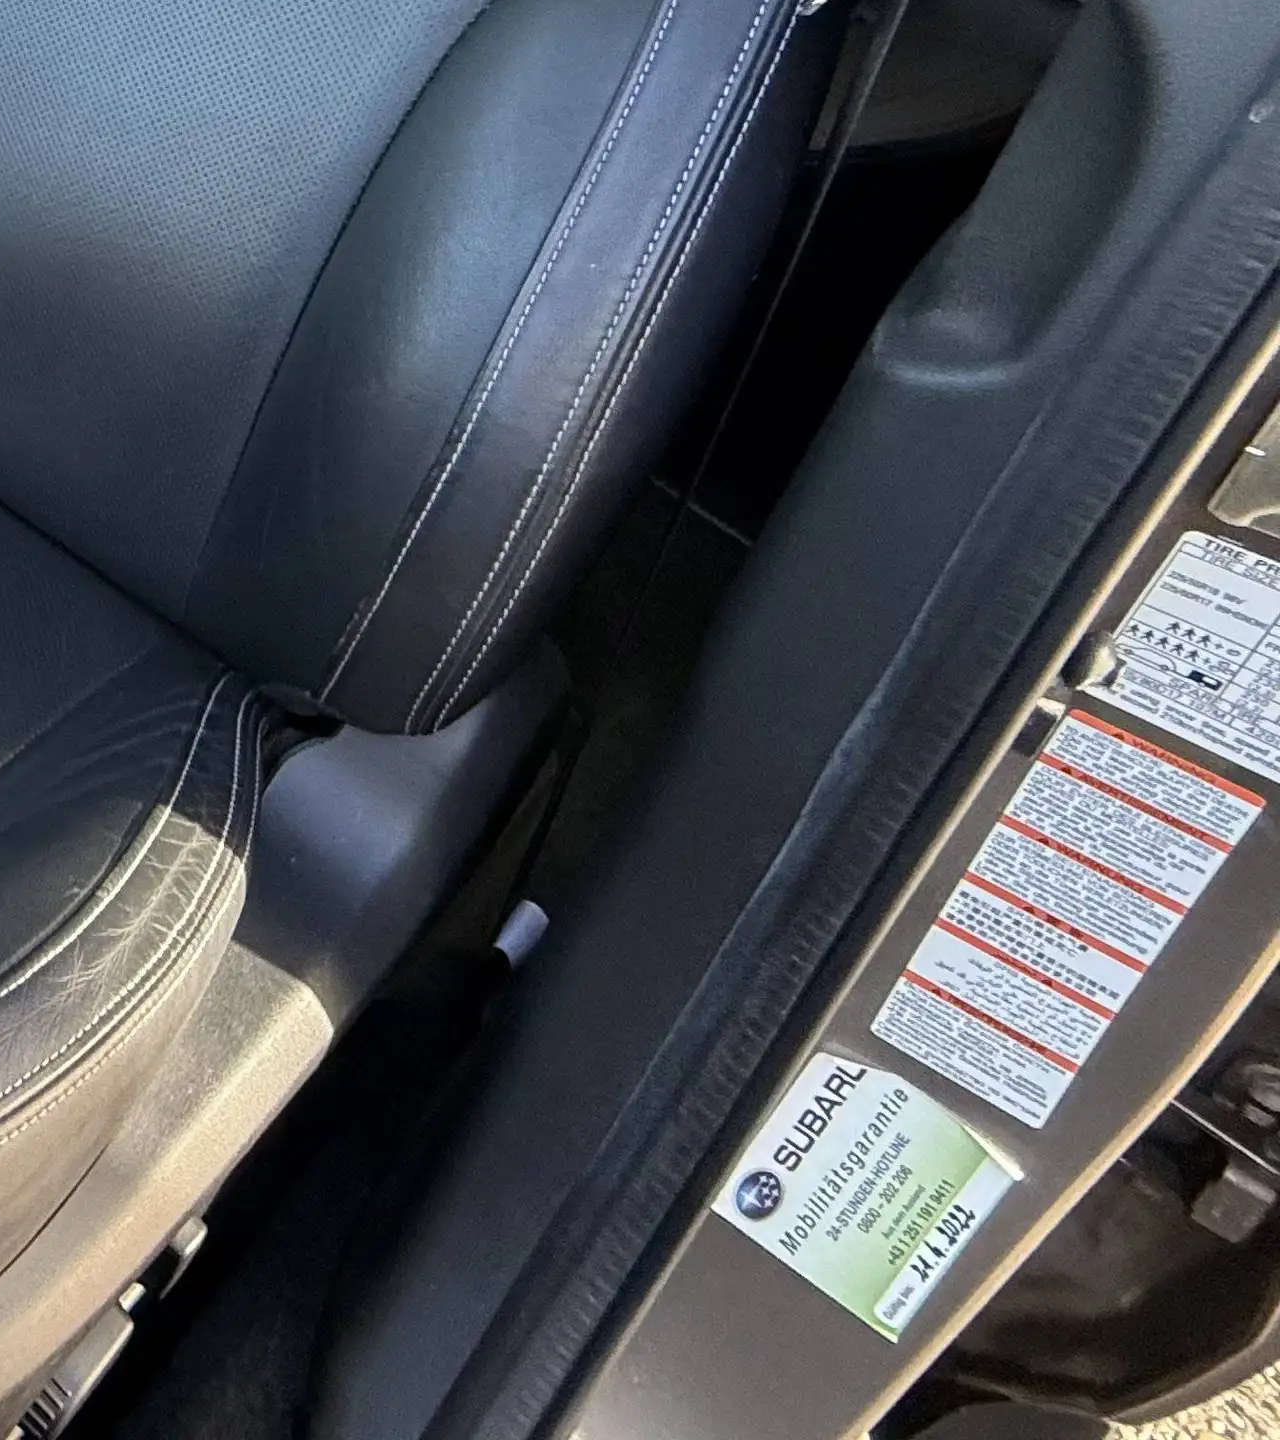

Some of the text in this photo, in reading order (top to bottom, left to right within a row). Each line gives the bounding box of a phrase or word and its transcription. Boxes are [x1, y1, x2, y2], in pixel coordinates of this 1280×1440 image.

[1204, 539, 1246, 561] TIRE
[779, 1088, 909, 1255] Mobilitätsgarantie
[826, 1133, 910, 1242] 24-STUNDEN-HOTLINE
